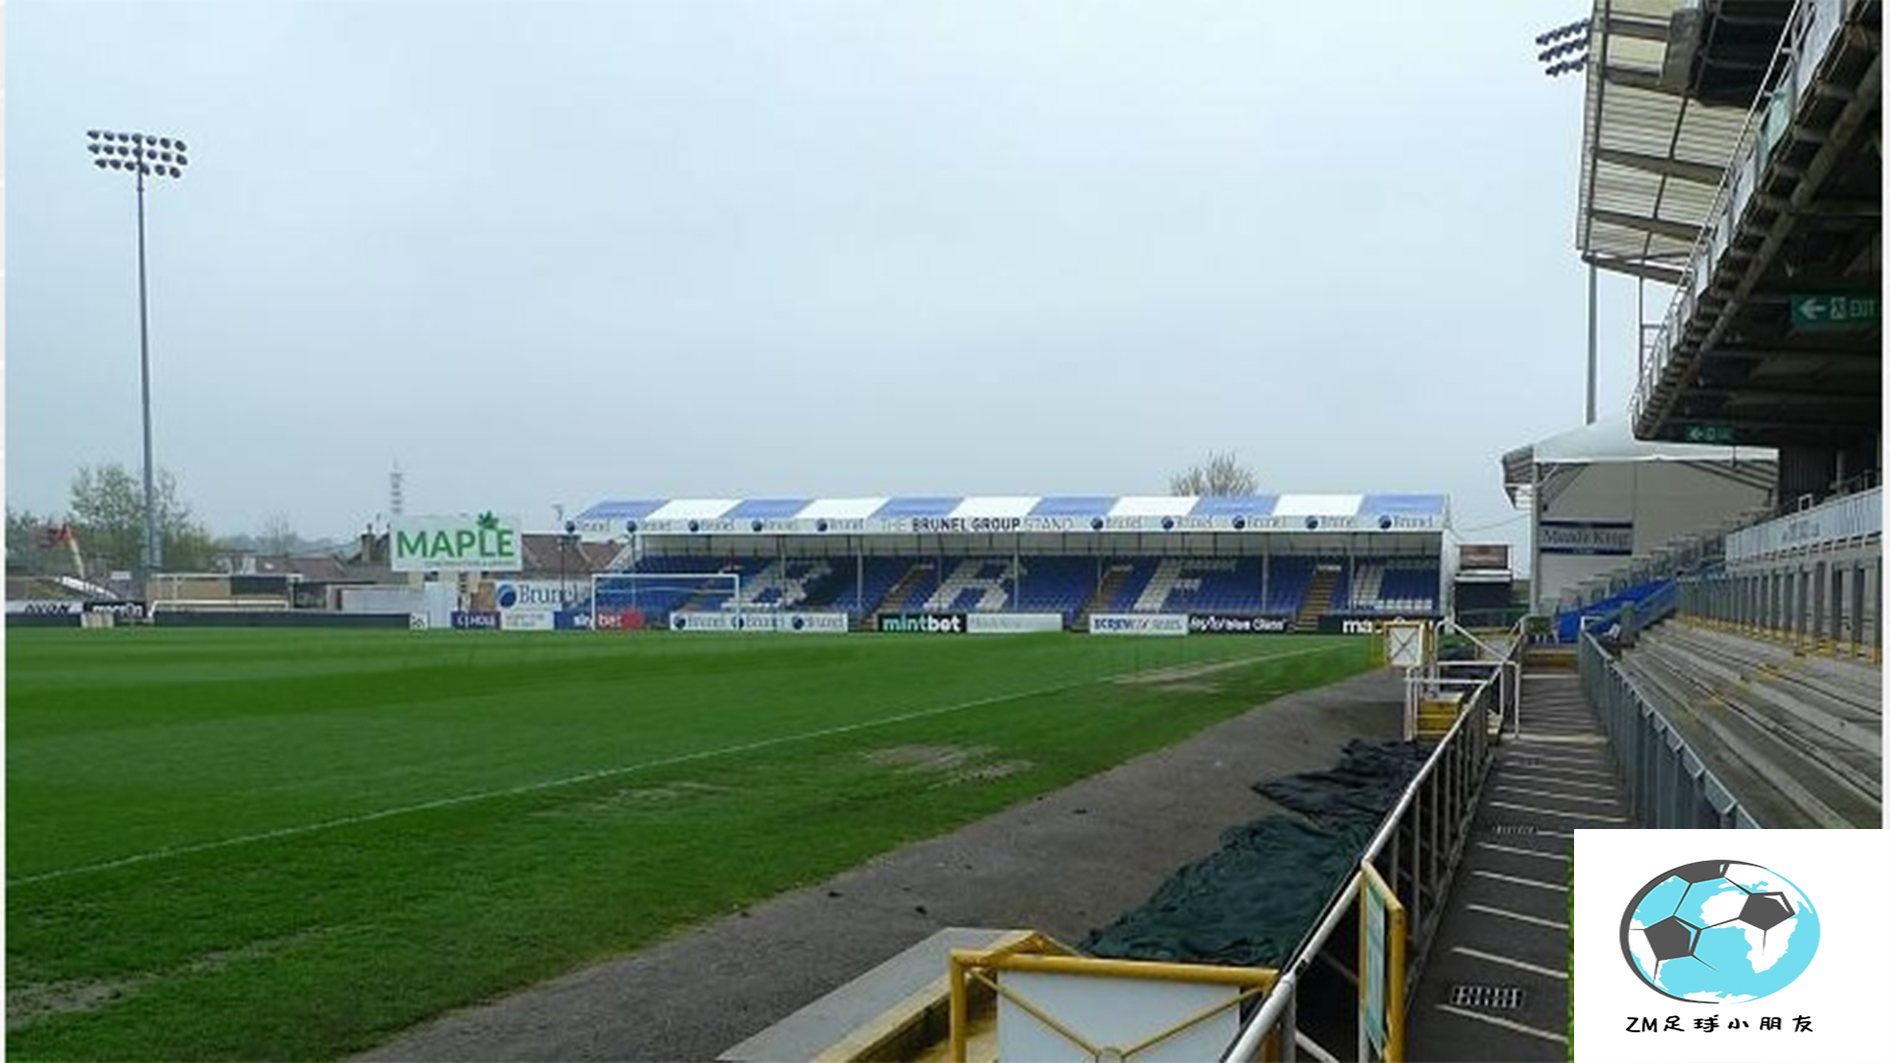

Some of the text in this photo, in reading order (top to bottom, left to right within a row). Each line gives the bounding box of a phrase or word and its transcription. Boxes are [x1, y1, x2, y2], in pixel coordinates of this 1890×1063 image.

[912, 518, 967, 531] BRUNEL
[971, 518, 1021, 531] GROUP
[396, 529, 515, 559] MAPLE
